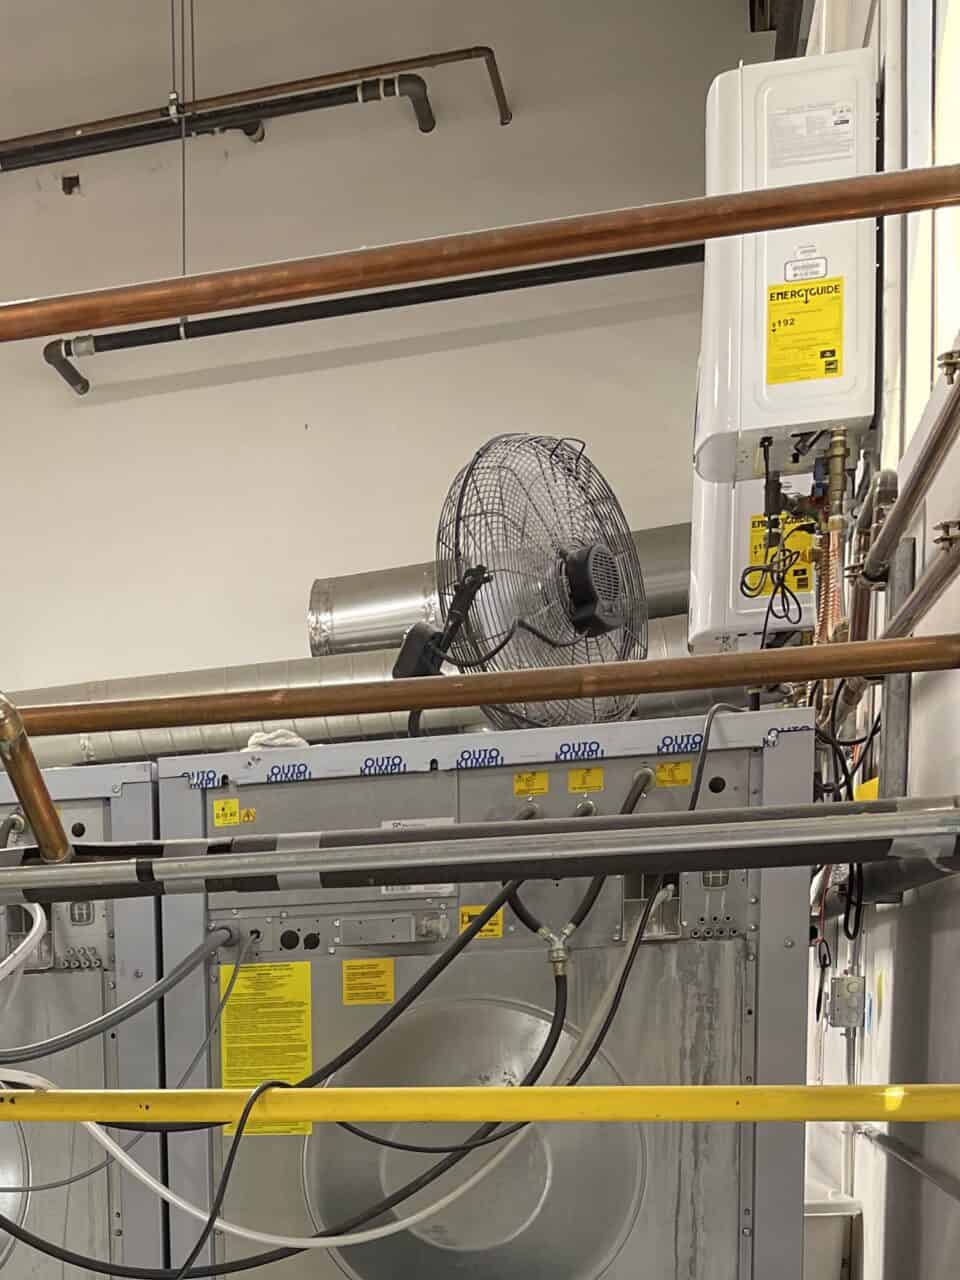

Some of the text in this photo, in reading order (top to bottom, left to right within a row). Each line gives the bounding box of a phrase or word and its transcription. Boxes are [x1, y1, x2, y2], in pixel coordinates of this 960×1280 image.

[663, 733, 703, 746] OUTO
[560, 741, 600, 753] OUTO
[461, 748, 500, 761] OUTO
[364, 755, 402, 768] OUTO
[271, 763, 307, 776] OUTO
